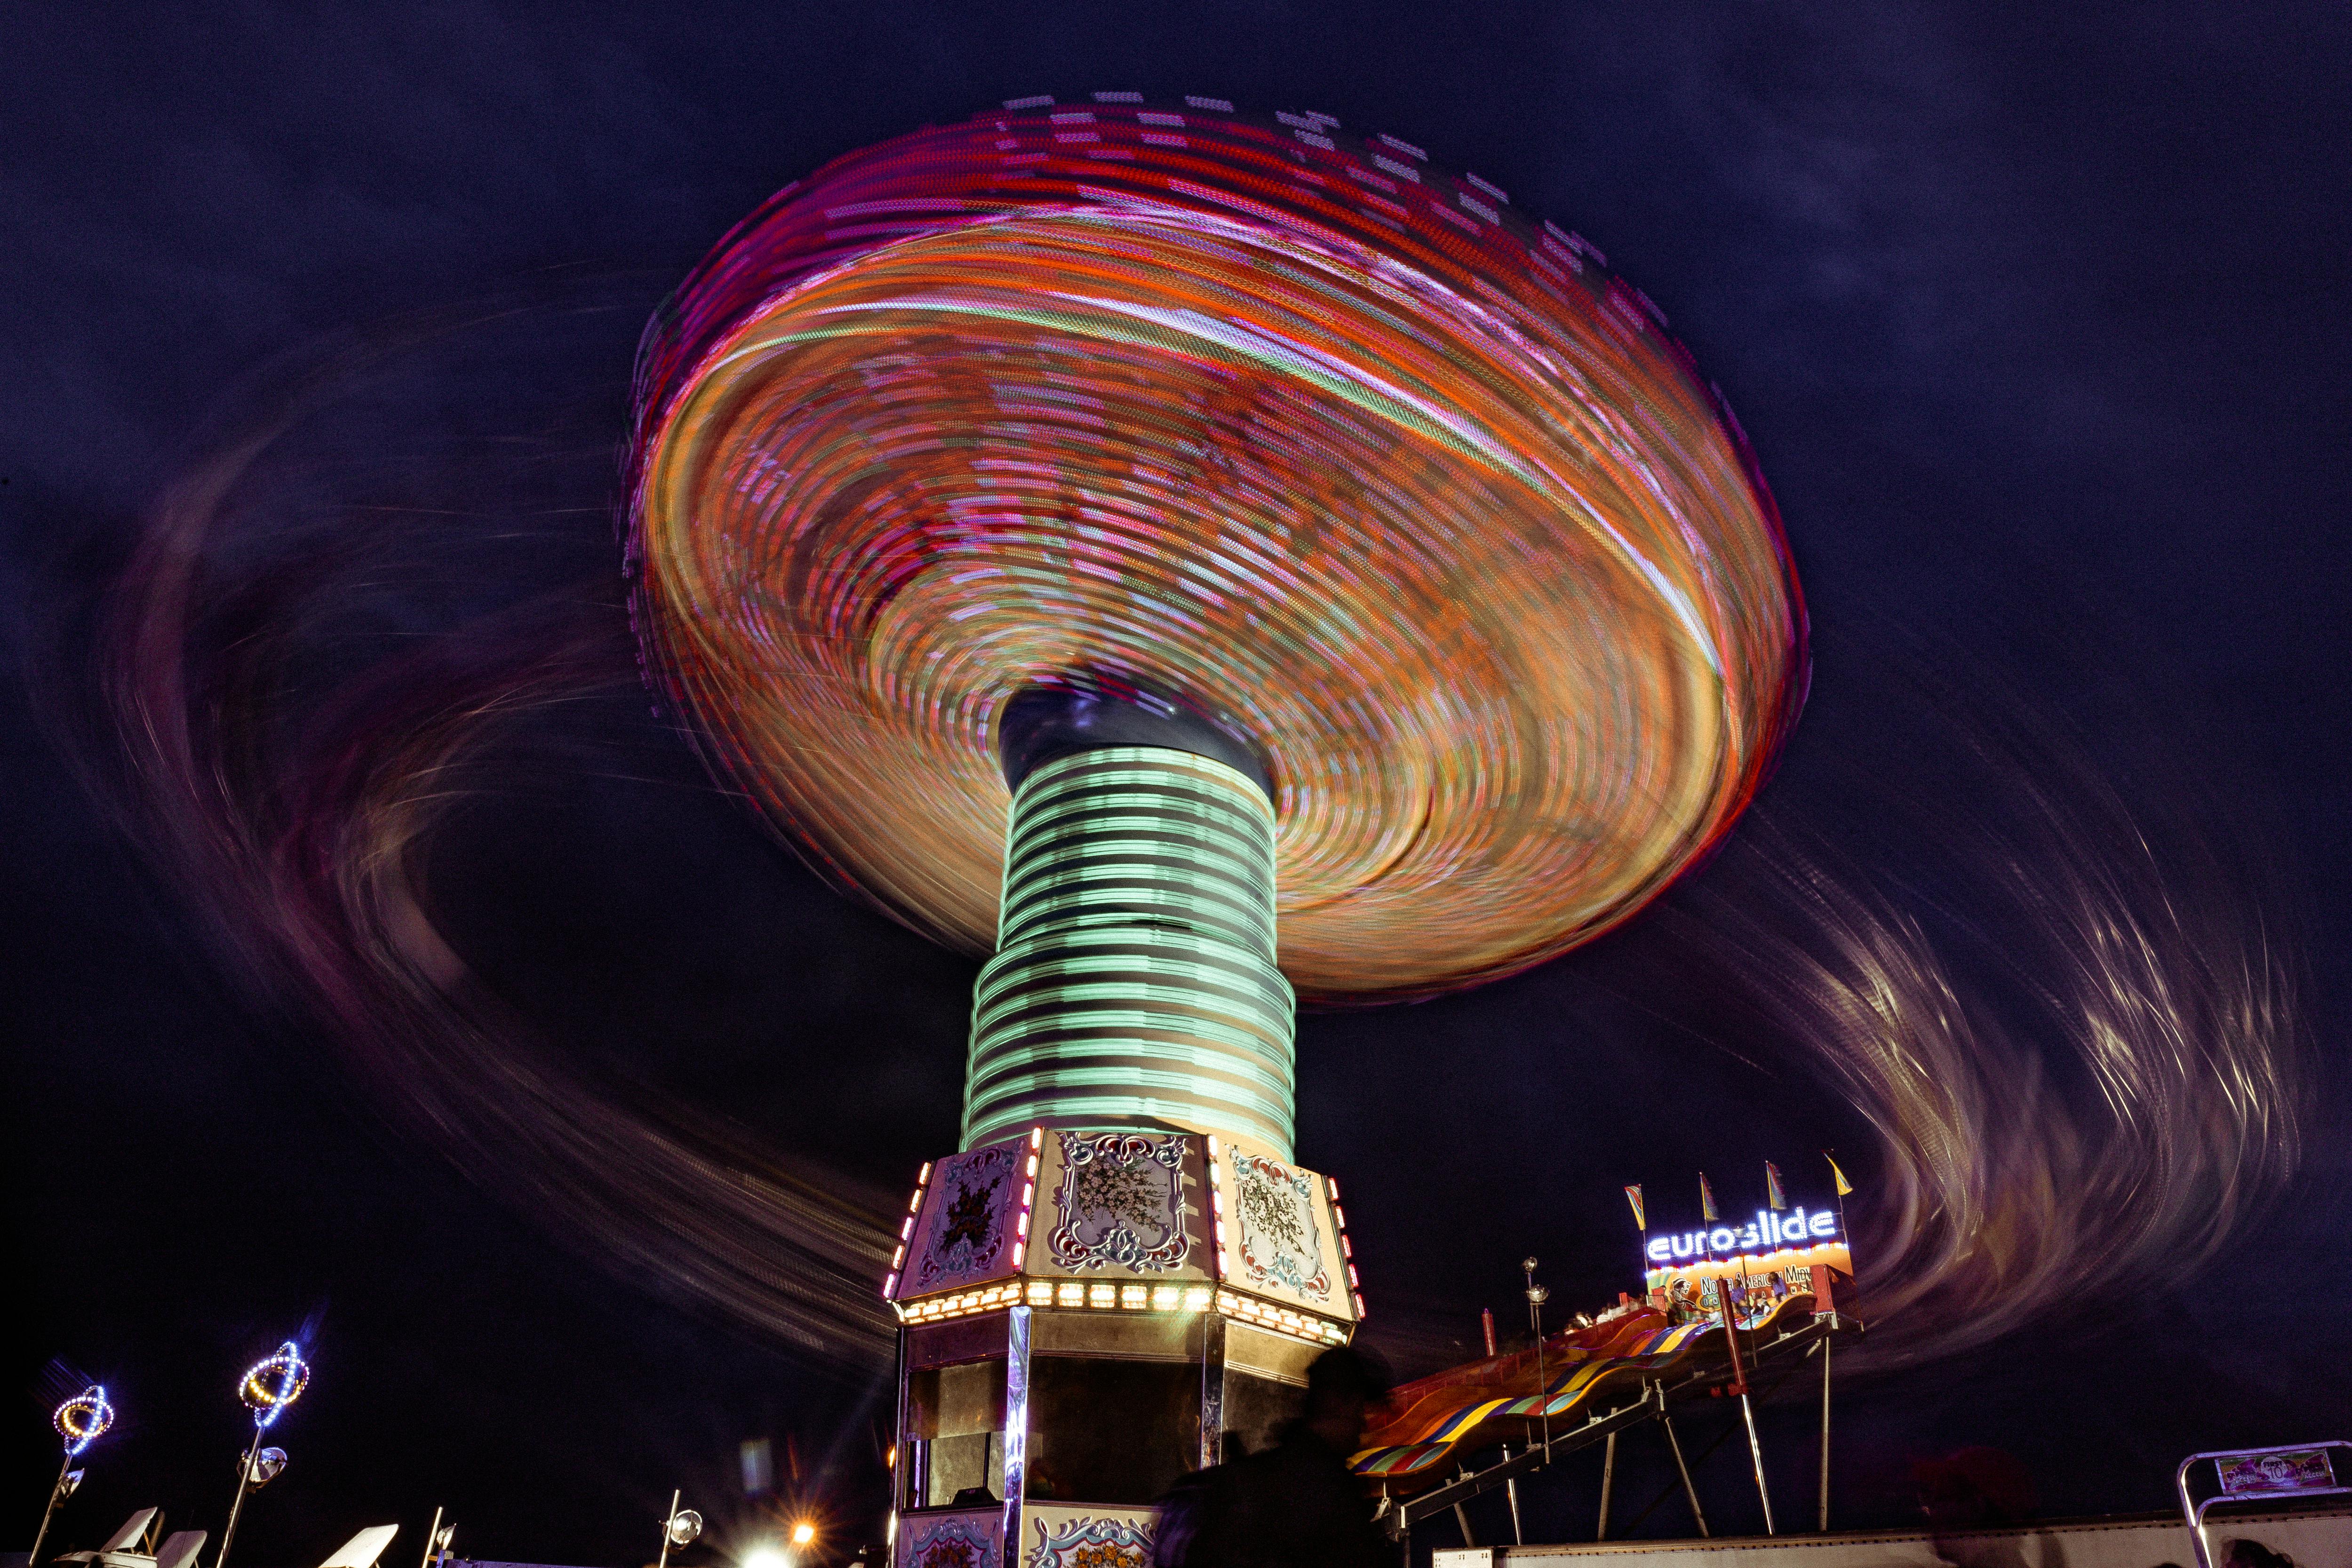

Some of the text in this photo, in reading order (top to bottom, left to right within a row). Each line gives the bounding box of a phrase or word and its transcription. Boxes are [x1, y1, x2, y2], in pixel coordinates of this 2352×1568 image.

[1700, 1277, 1733, 1296] NOH
[1736, 1272, 1783, 1289] AMERIC
[2267, 1466, 2283, 1479] 10
